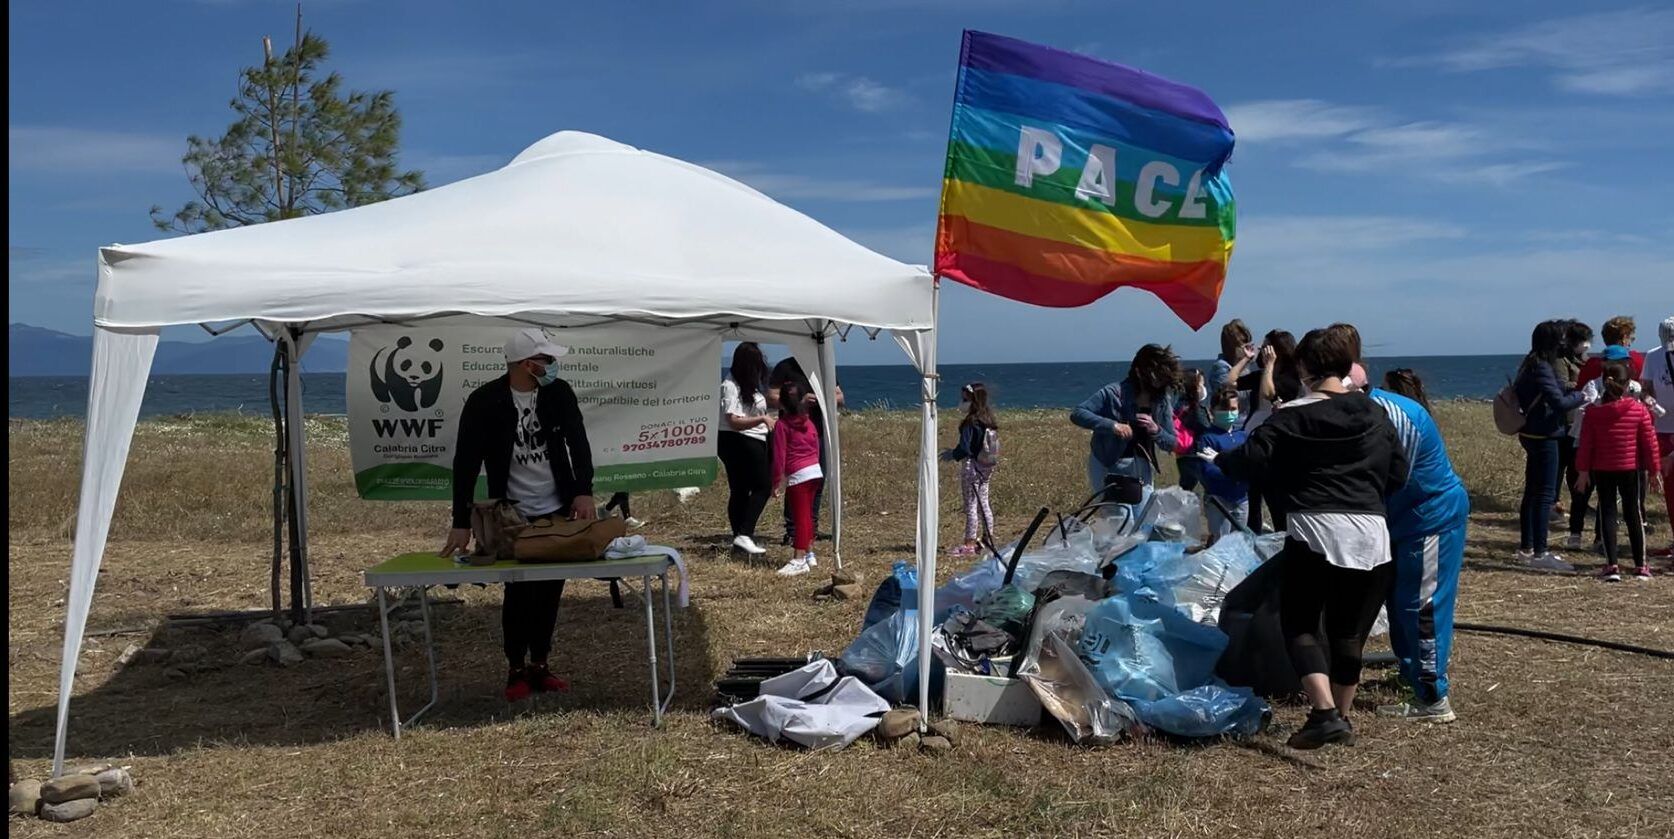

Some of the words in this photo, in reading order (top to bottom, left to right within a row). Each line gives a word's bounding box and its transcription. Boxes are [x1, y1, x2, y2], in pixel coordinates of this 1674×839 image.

[1014, 124, 1208, 219] PACE
[462, 344, 505, 354] Escurs
[578, 346, 655, 357] naturalistiche
[462, 361, 508, 371] Educaz
[559, 362, 599, 372] ientale
[569, 379, 614, 390] Cittadini
[616, 380, 658, 390] virtuosi
[642, 398, 660, 407] del
[662, 394, 711, 407] territorio
[372, 419, 444, 438] WWF
[639, 423, 707, 442] 5x1000
[374, 444, 418, 454] Calabria
[421, 444, 446, 453] Citra
[622, 436, 706, 453] 97034780789
[653, 469, 686, 478] Calabria
